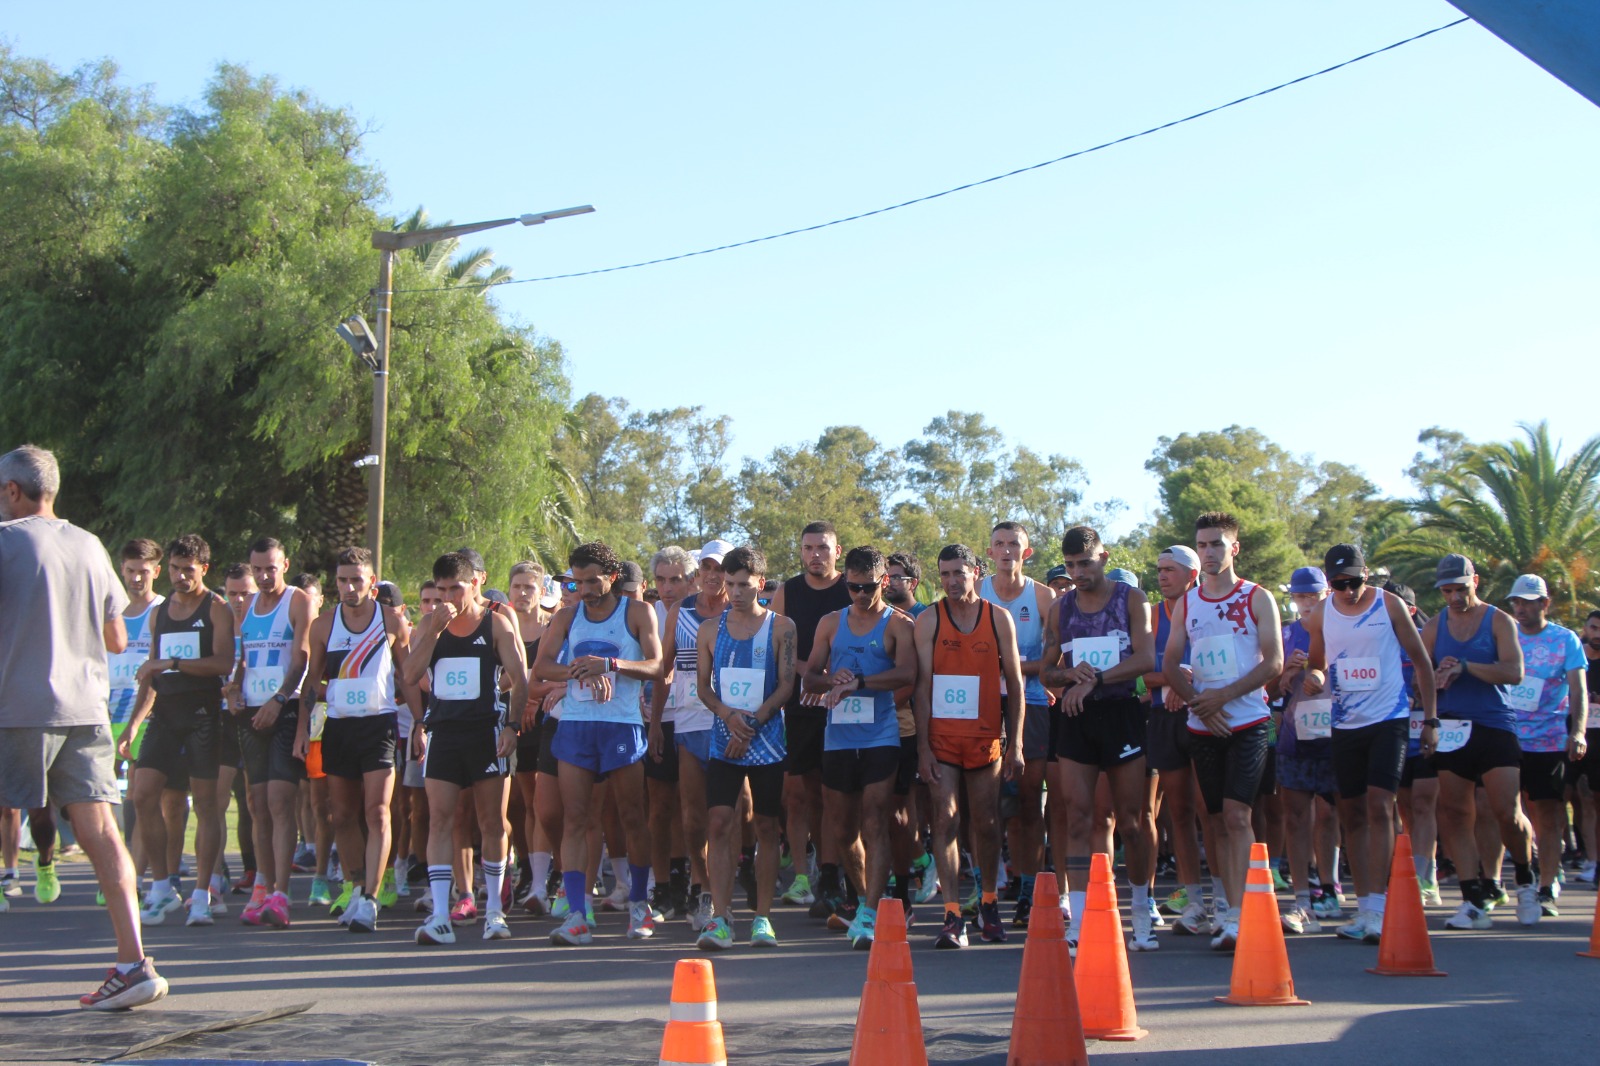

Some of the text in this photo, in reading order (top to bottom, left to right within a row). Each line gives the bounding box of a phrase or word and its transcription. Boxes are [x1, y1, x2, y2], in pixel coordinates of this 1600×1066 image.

[165, 645, 193, 658] 120
[1079, 650, 1112, 666] 107
[1196, 649, 1227, 667] 111
[446, 671, 467, 686] 65
[1343, 668, 1377, 680] 1400
[252, 678, 278, 693] 116
[729, 682, 752, 697] 67
[346, 690, 367, 705] 88
[944, 689, 967, 705] 68
[843, 698, 862, 713] 78
[1301, 711, 1331, 727] 176
[1411, 720, 1425, 730] 07
